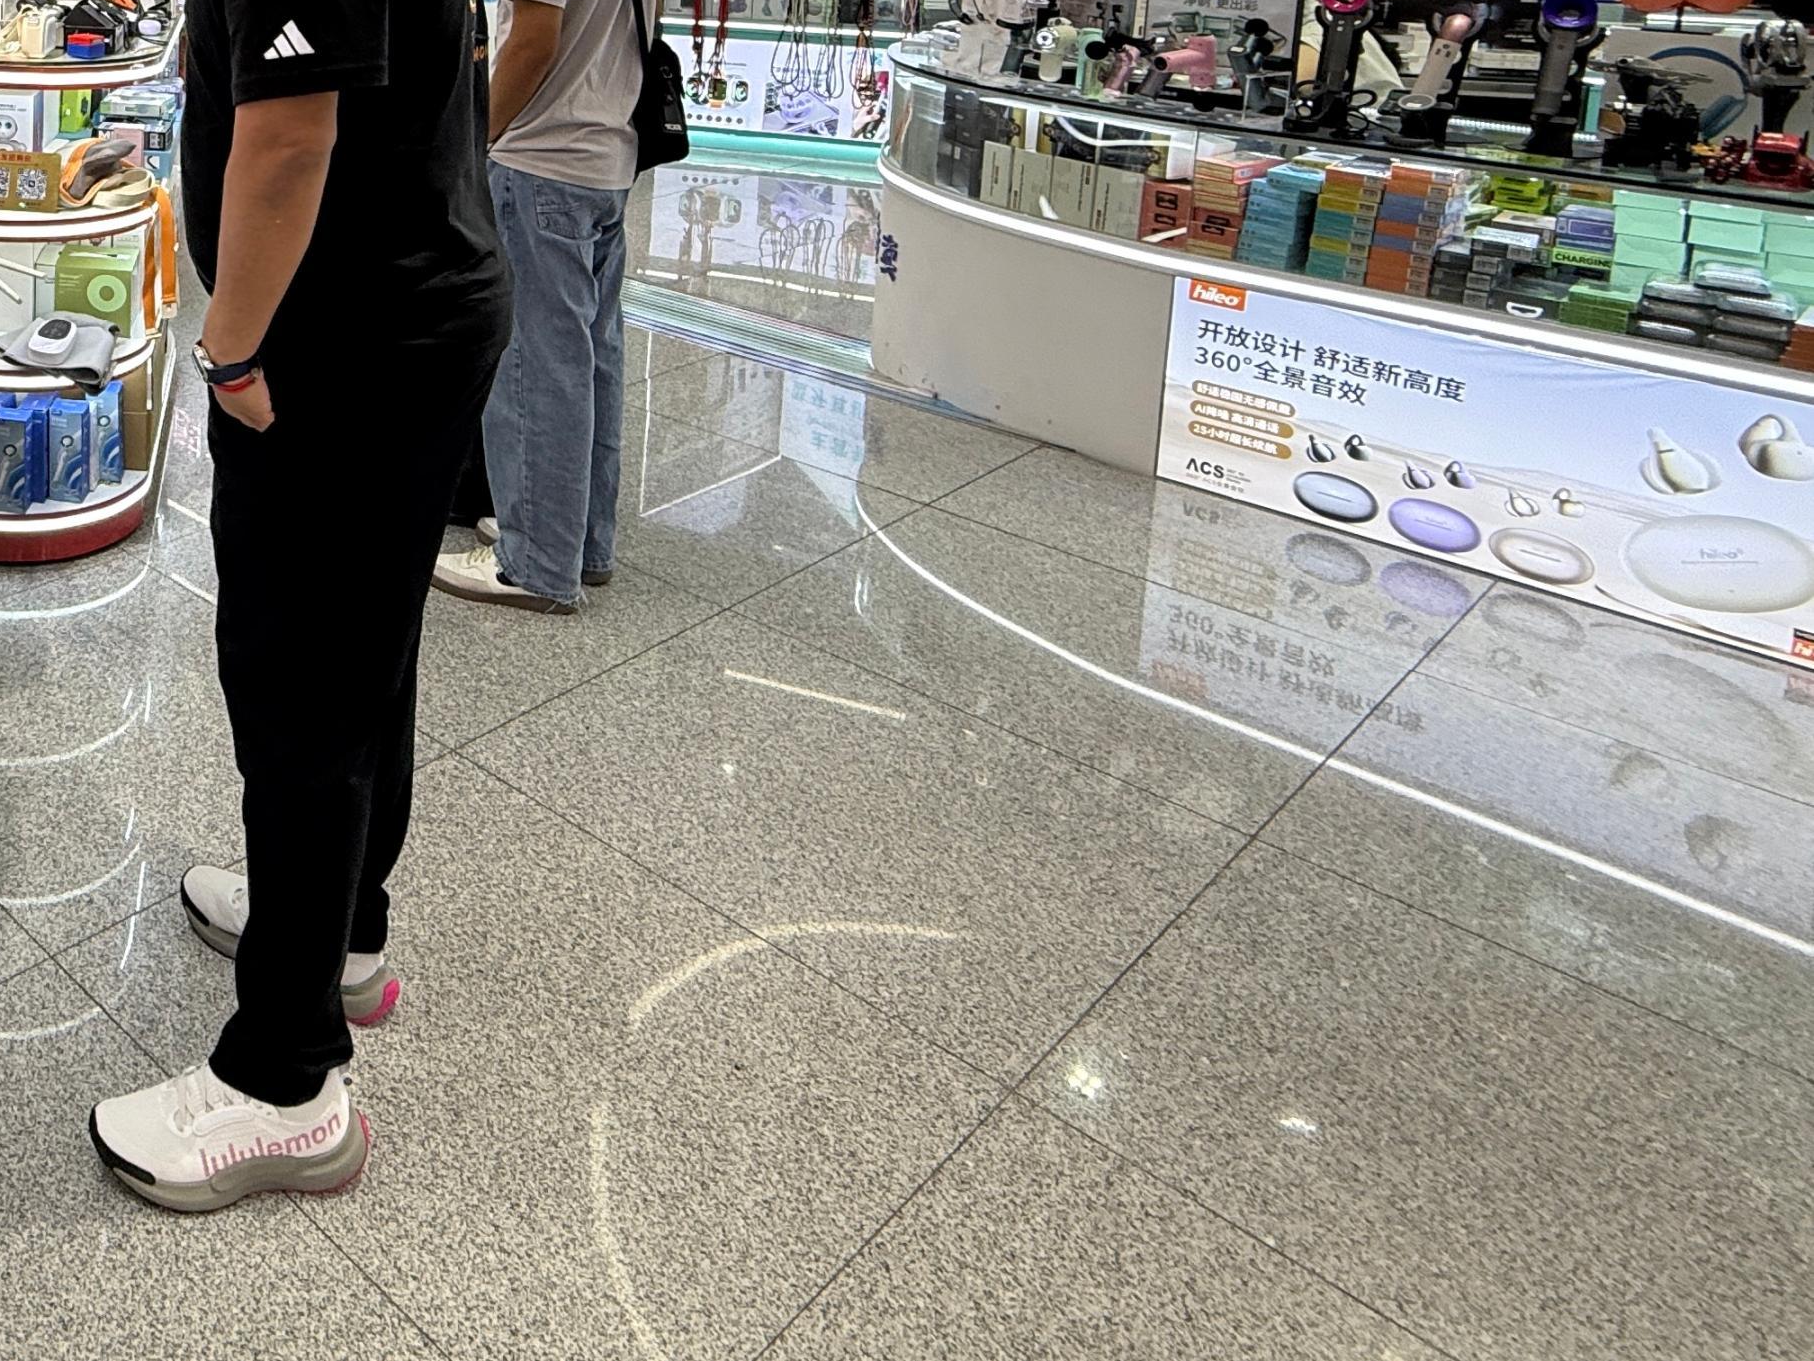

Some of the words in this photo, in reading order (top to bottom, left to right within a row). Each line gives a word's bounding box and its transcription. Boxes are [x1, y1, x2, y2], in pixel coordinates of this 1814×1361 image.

[1191, 283, 1242, 307] hileo
[1193, 345, 1368, 407] 360°全景音效
[1196, 318, 1307, 364] 开放设计
[1313, 345, 1467, 404] 舒适新高度
